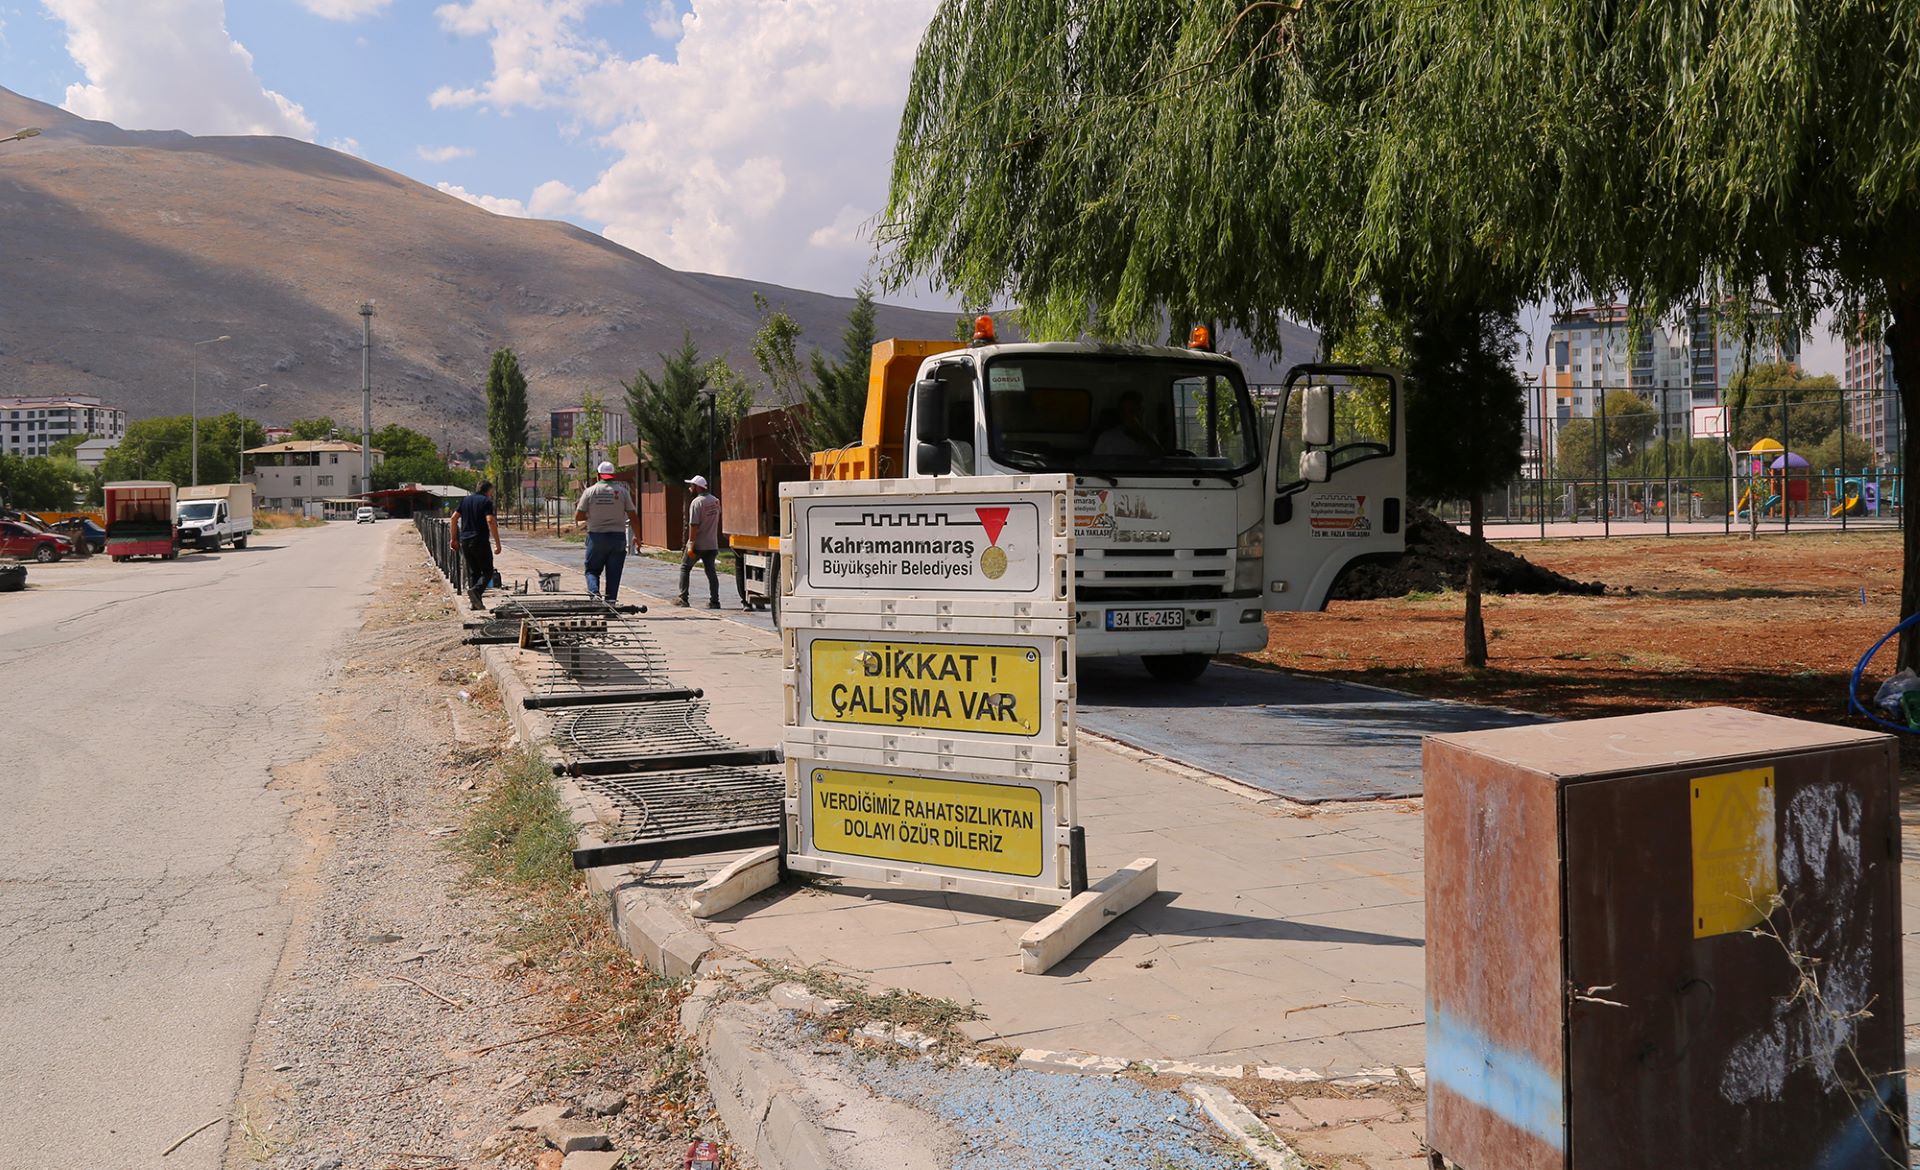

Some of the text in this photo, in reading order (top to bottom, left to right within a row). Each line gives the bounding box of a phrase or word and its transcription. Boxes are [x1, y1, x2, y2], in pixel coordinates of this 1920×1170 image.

[820, 537, 975, 558] Kahramanmaraş
[822, 560, 973, 579] Büyükşehir Belediyesi
[1116, 612, 1130, 626] 34
[1135, 611, 1149, 626] KE
[1155, 611, 1182, 625] 2453
[863, 645, 997, 682] DİKKAT !
[831, 684, 1018, 722] ÇALIŞMA VAR
[820, 790, 1034, 830] VERDİĞİMİZ RAHATSIZLIKTAN
[844, 819, 1003, 853] DOLAYI ÖZÜR DİLERİZ
